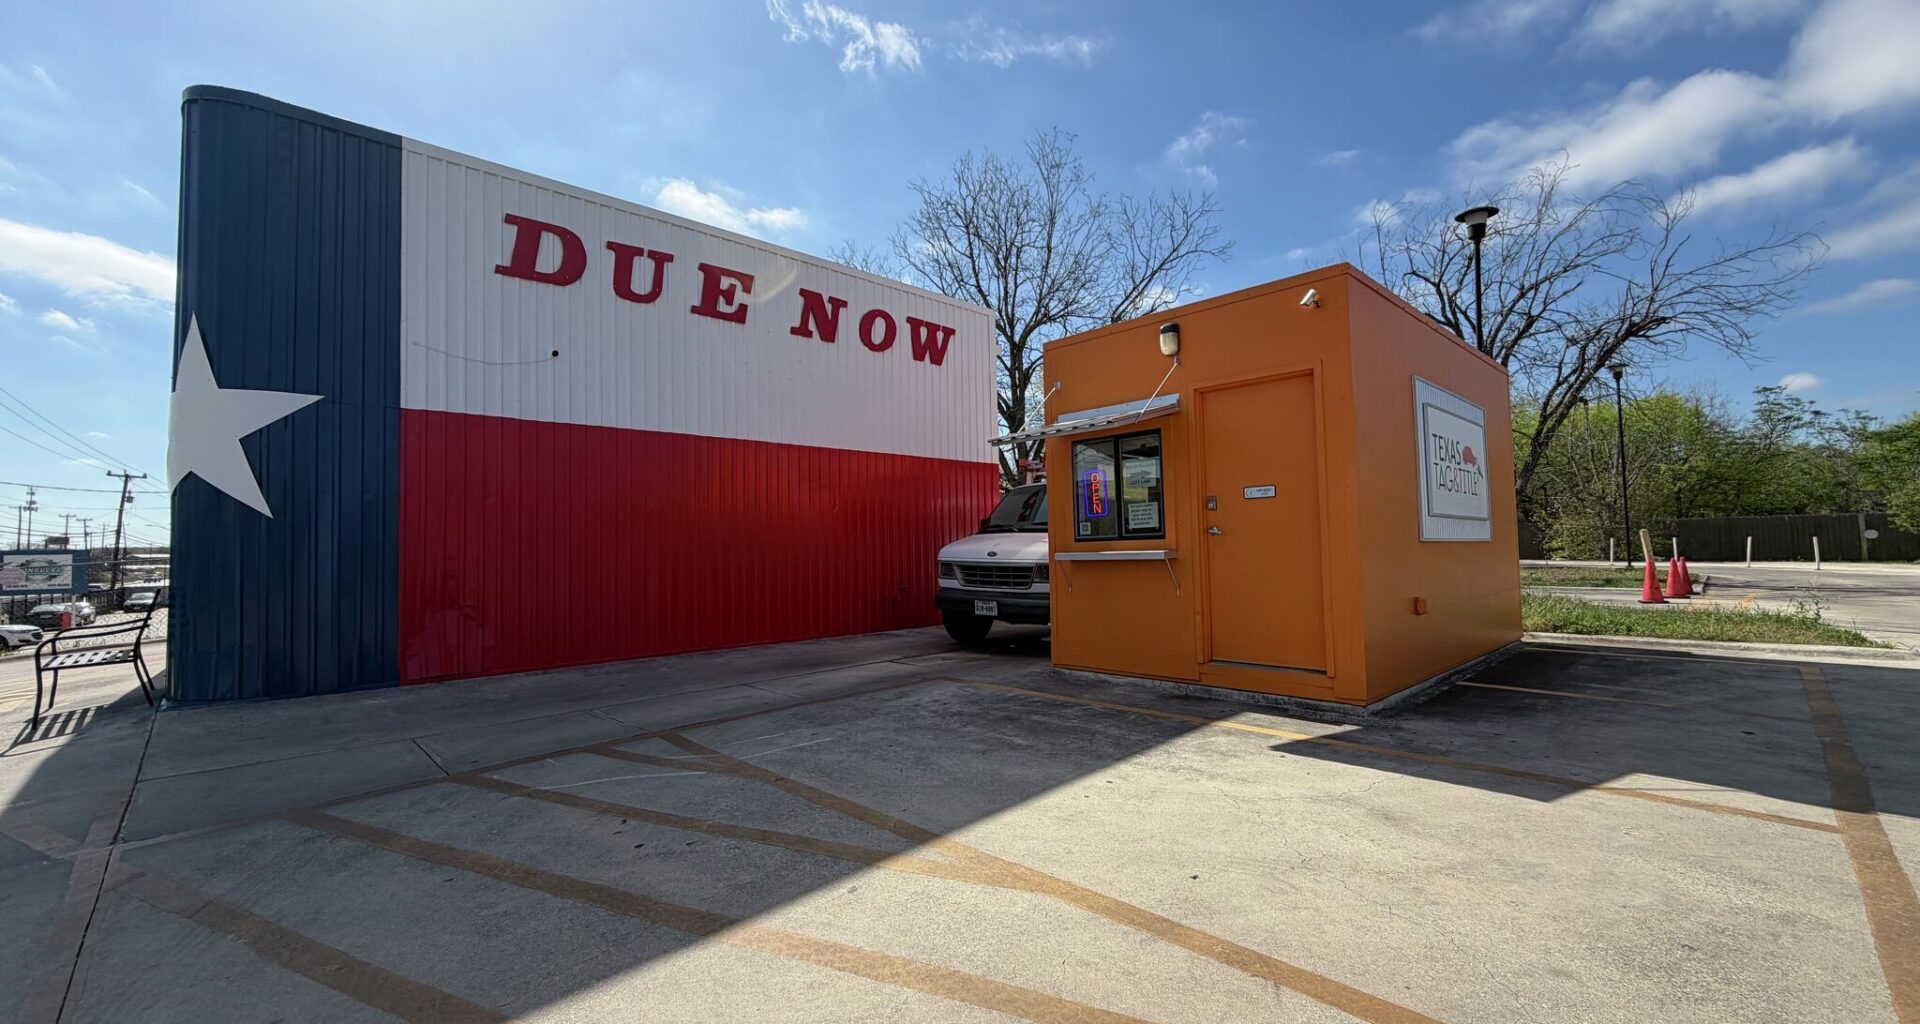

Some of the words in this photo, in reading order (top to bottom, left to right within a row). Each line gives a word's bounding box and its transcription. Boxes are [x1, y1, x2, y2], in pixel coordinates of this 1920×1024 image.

[494, 213, 755, 324] DUE
[789, 288, 956, 366] NOW
[1432, 433, 1462, 466] TEXAS
[1091, 472, 1102, 514] OPEN
[1433, 462, 1479, 496] TAG&TITLE
